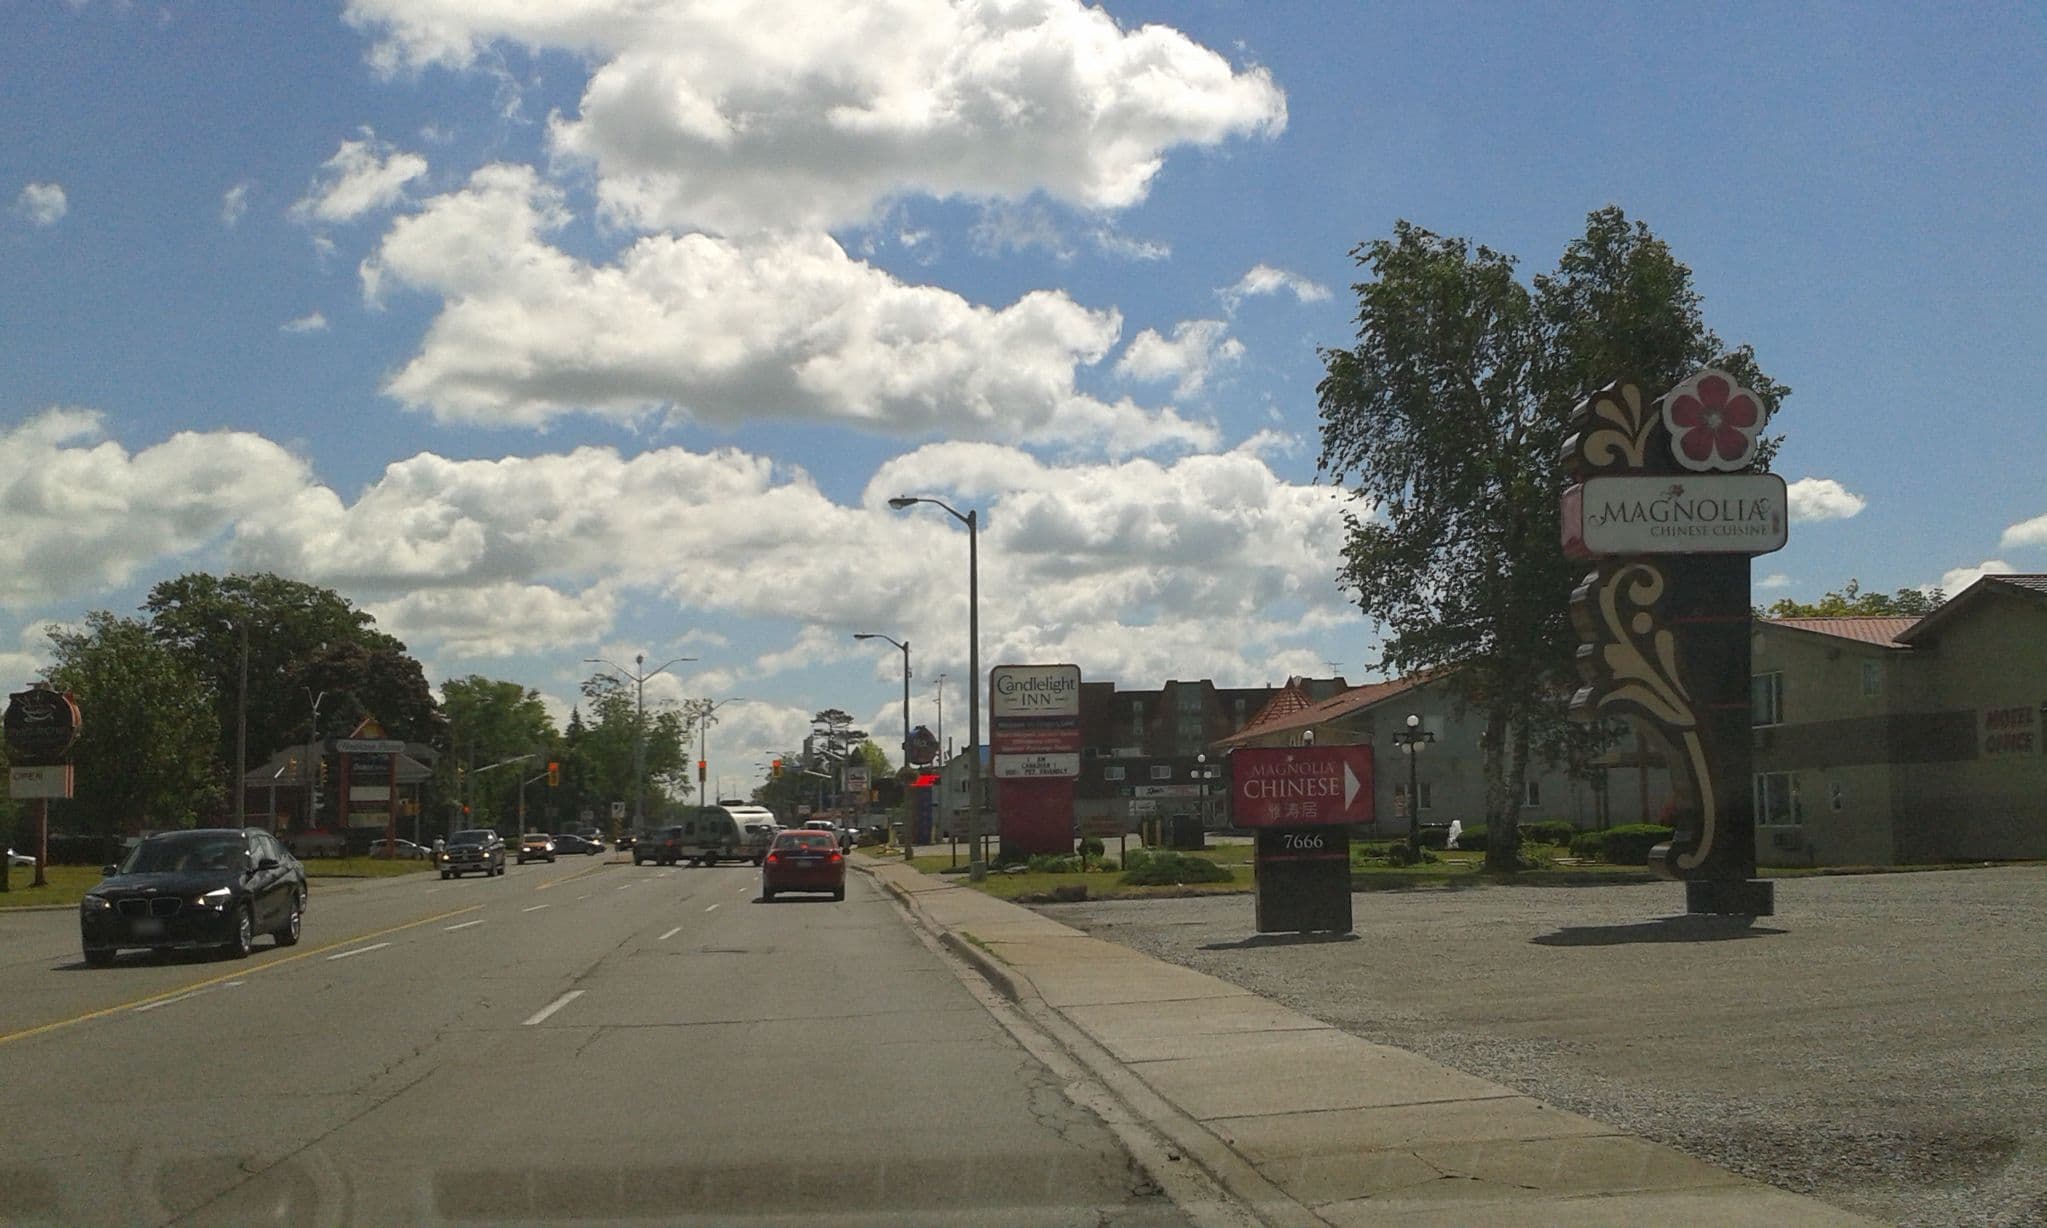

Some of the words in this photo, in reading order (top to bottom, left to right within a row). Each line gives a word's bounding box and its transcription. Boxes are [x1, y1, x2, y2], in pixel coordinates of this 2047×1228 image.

[1600, 499, 1767, 525] MAGNOLIA
[1650, 524, 1706, 537] CHINESE
[1712, 523, 1767, 536] CUISINE
[997, 675, 1076, 695] Candlelight
[1022, 693, 1051, 706] INN
[1251, 762, 1334, 776] MAGNOLIA
[1243, 778, 1340, 799] CHINESE
[1283, 834, 1323, 849] 7666
